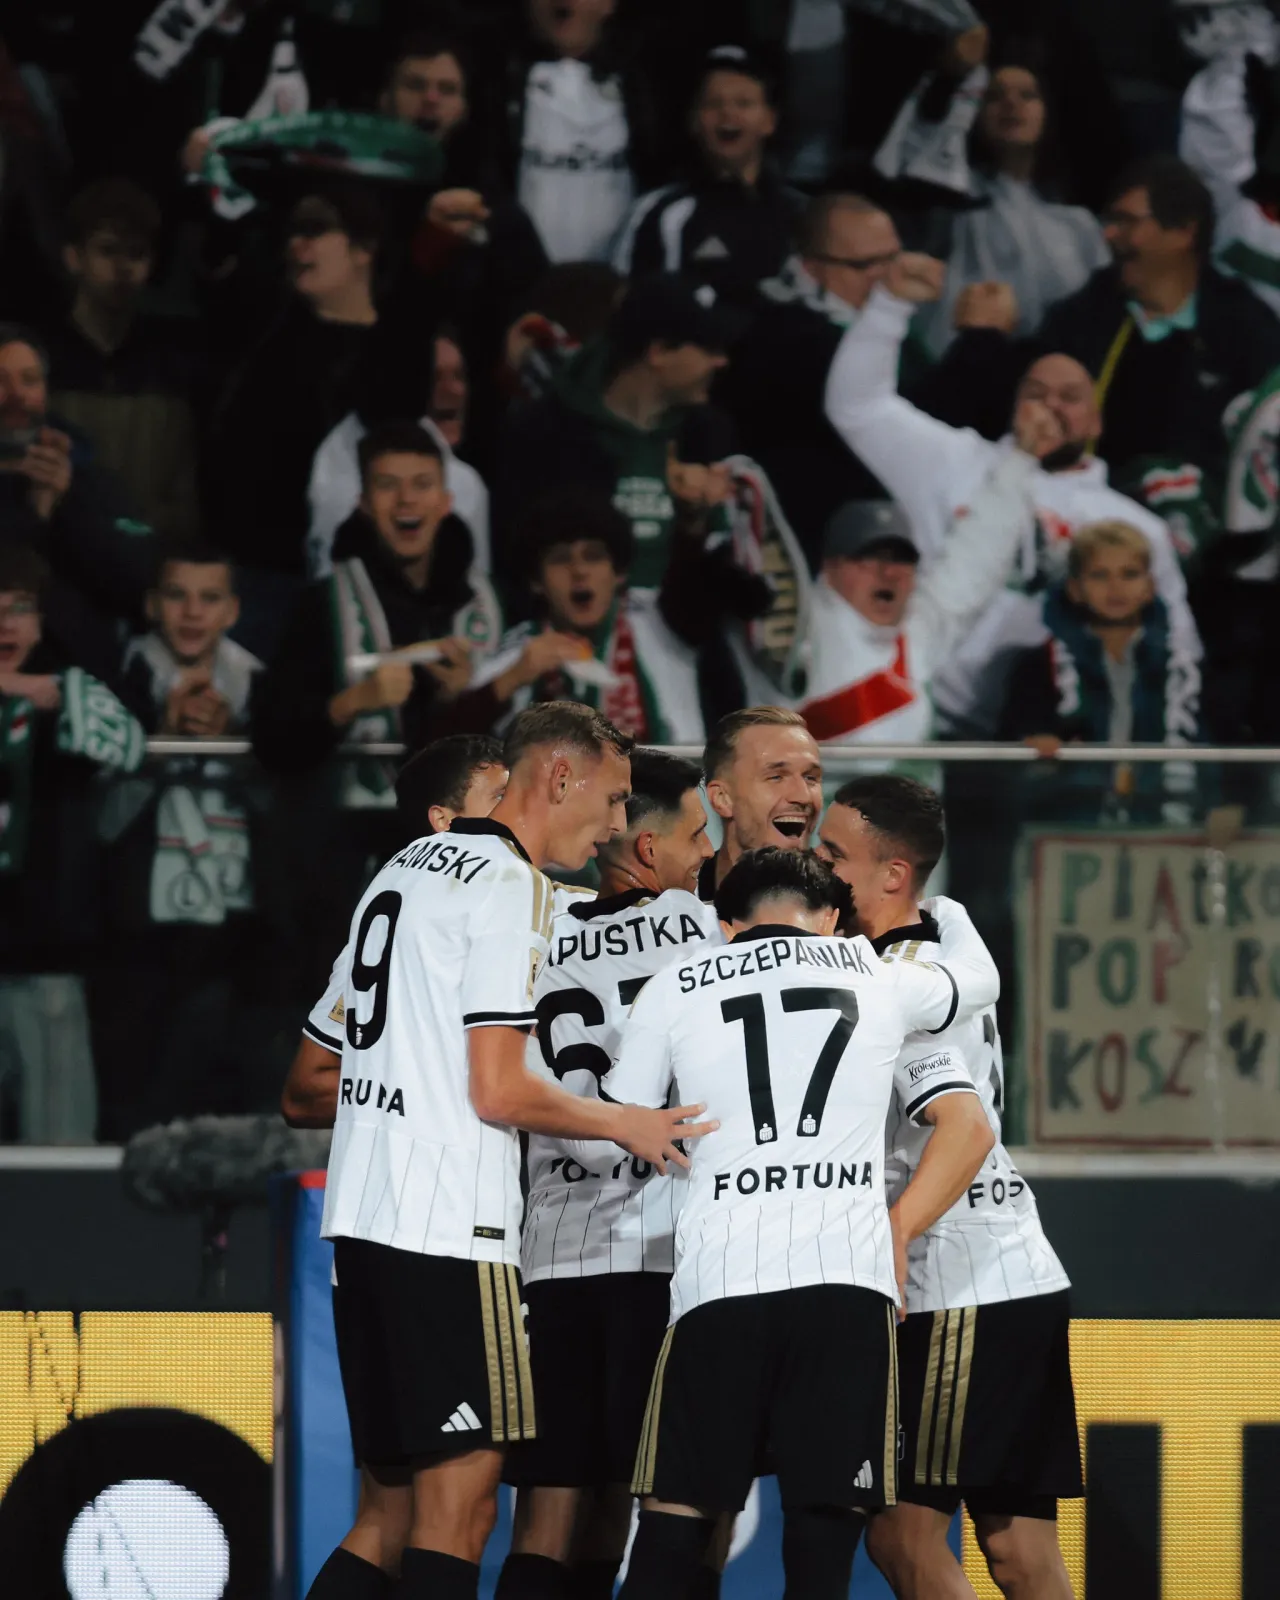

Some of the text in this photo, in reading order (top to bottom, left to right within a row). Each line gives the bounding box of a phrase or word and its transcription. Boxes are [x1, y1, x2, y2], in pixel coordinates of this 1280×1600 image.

[383, 841, 492, 884] AMSKI
[548, 913, 707, 967] PUSTKA
[677, 937, 875, 994] SZCZEPANIAK
[346, 890, 403, 1050] 9
[534, 974, 656, 1102] 6
[719, 987, 860, 1146] 17
[713, 1160, 874, 1201] FORTUNA
